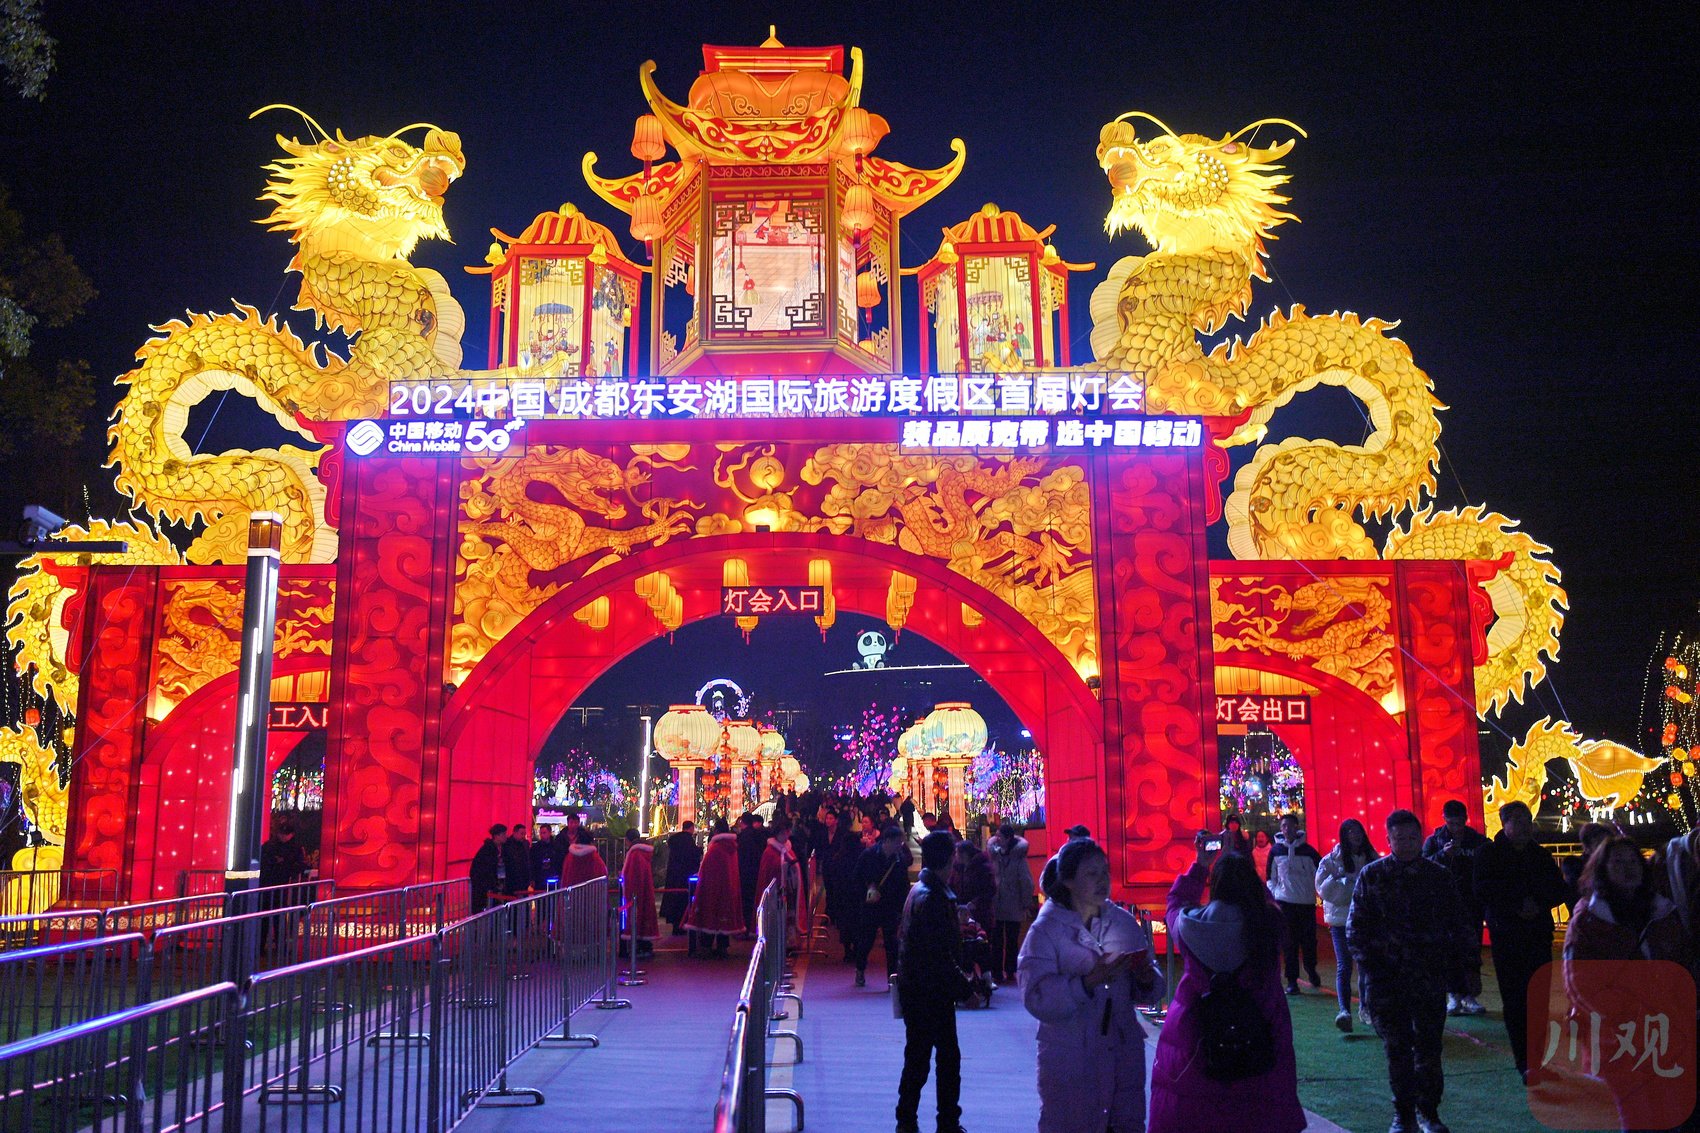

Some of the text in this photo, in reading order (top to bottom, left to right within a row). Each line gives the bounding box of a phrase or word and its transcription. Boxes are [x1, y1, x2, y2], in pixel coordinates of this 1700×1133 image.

[389, 421, 462, 440] 中国移动
[388, 440, 461, 453] China Mobile
[724, 588, 819, 613] 灯会入口
[267, 705, 328, 729] 工入
[1215, 697, 1305, 722] 灯会出口
